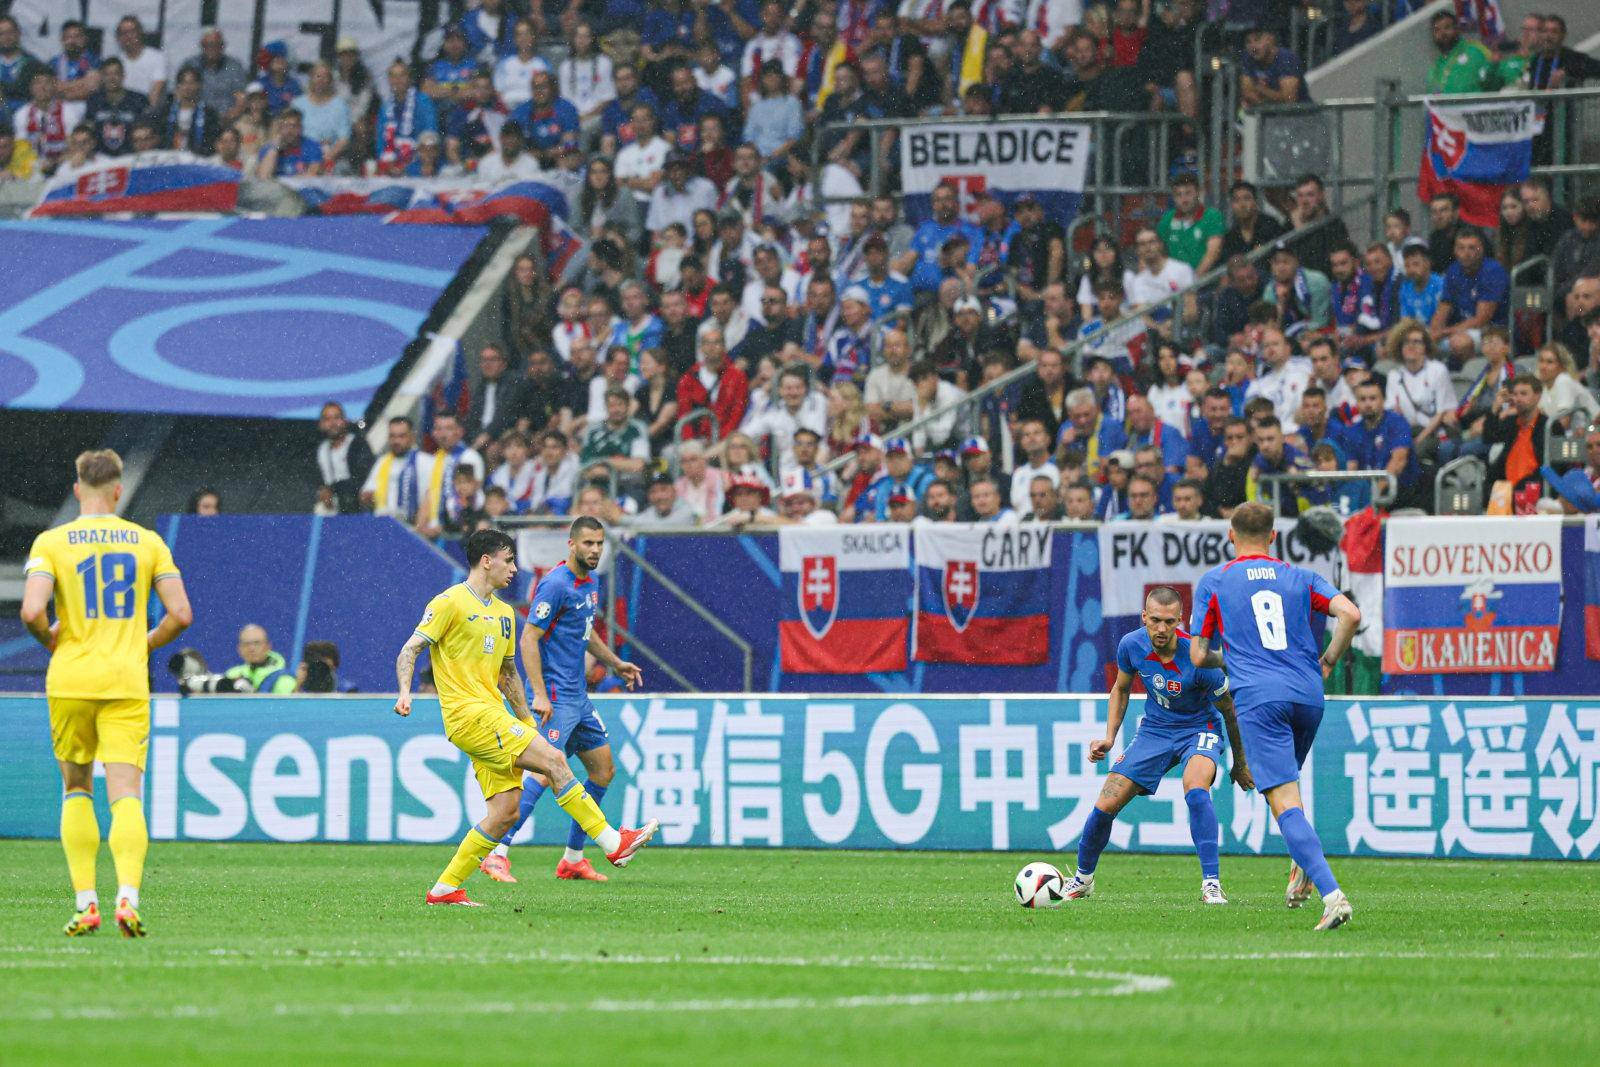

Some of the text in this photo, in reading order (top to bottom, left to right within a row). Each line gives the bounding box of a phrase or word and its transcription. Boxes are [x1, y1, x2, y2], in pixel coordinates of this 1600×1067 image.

[909, 129, 1079, 168] BELADICE
[67, 529, 140, 545] BRAZHKO
[841, 532, 902, 555] SKALICA
[1112, 532, 1149, 568] FK
[1246, 567, 1277, 581] DUDA
[1391, 540, 1553, 578] SLOVENSKO
[76, 552, 137, 619] 18
[498, 615, 512, 640] 19
[1250, 589, 1288, 651] 8
[1420, 630, 1556, 669] KAMENICA
[63, 699, 534, 843] isens
